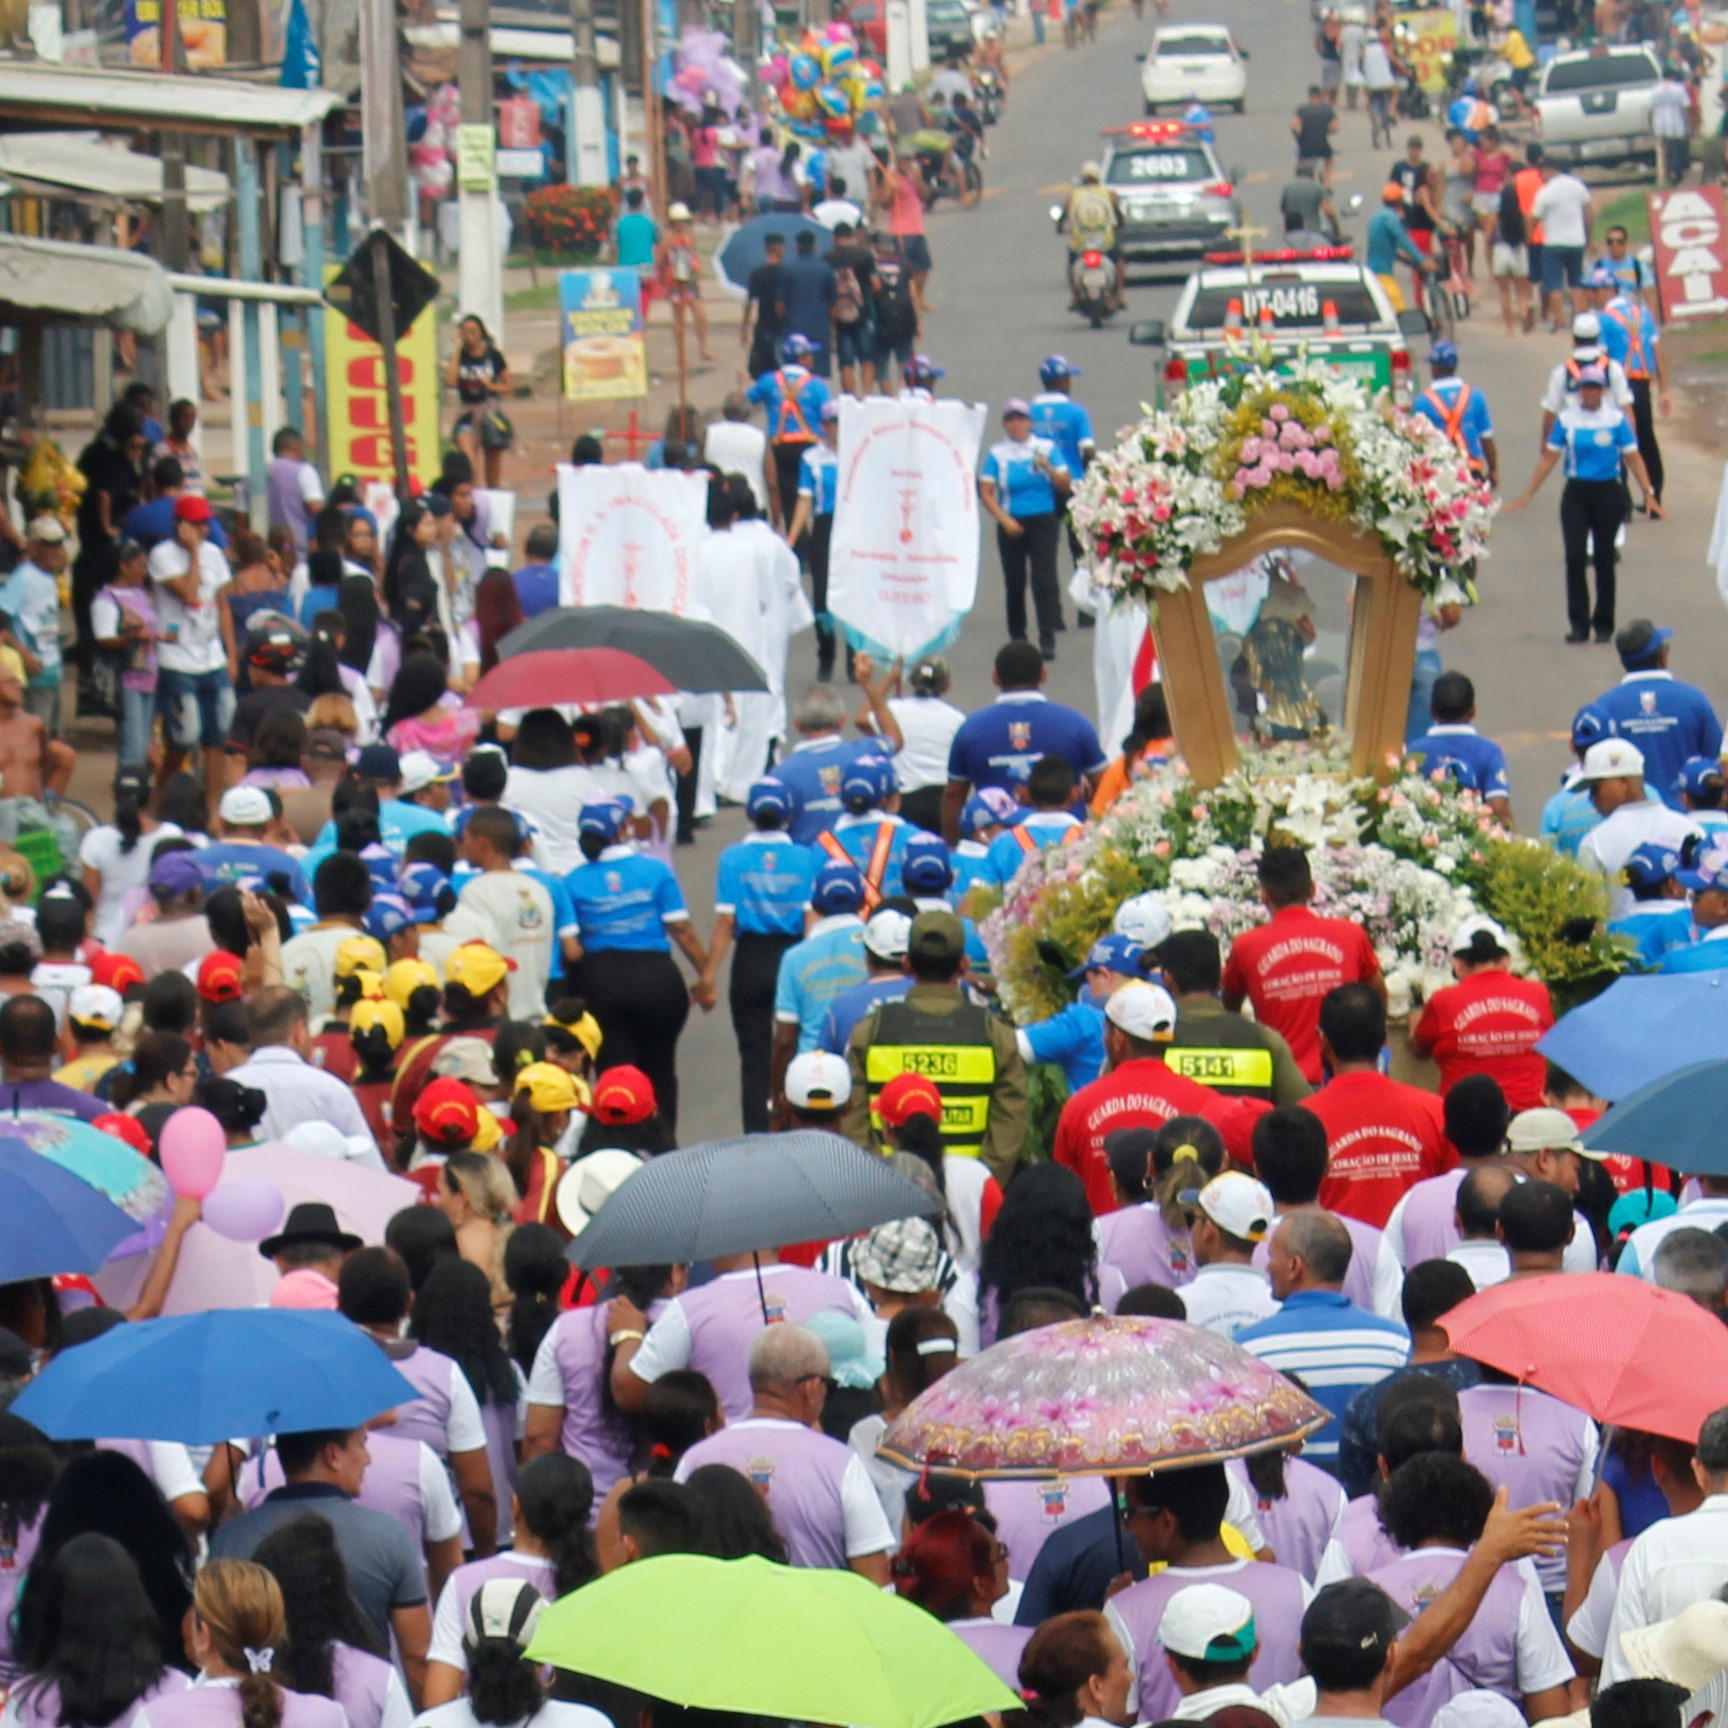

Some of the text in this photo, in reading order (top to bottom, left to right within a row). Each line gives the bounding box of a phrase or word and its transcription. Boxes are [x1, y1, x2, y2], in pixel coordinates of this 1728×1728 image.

[904, 1054, 956, 1074] 5236
[1181, 1055, 1235, 1077] 5141
[1087, 1096, 1127, 1131] GUARDA
[1128, 1094, 1142, 1110] DO
